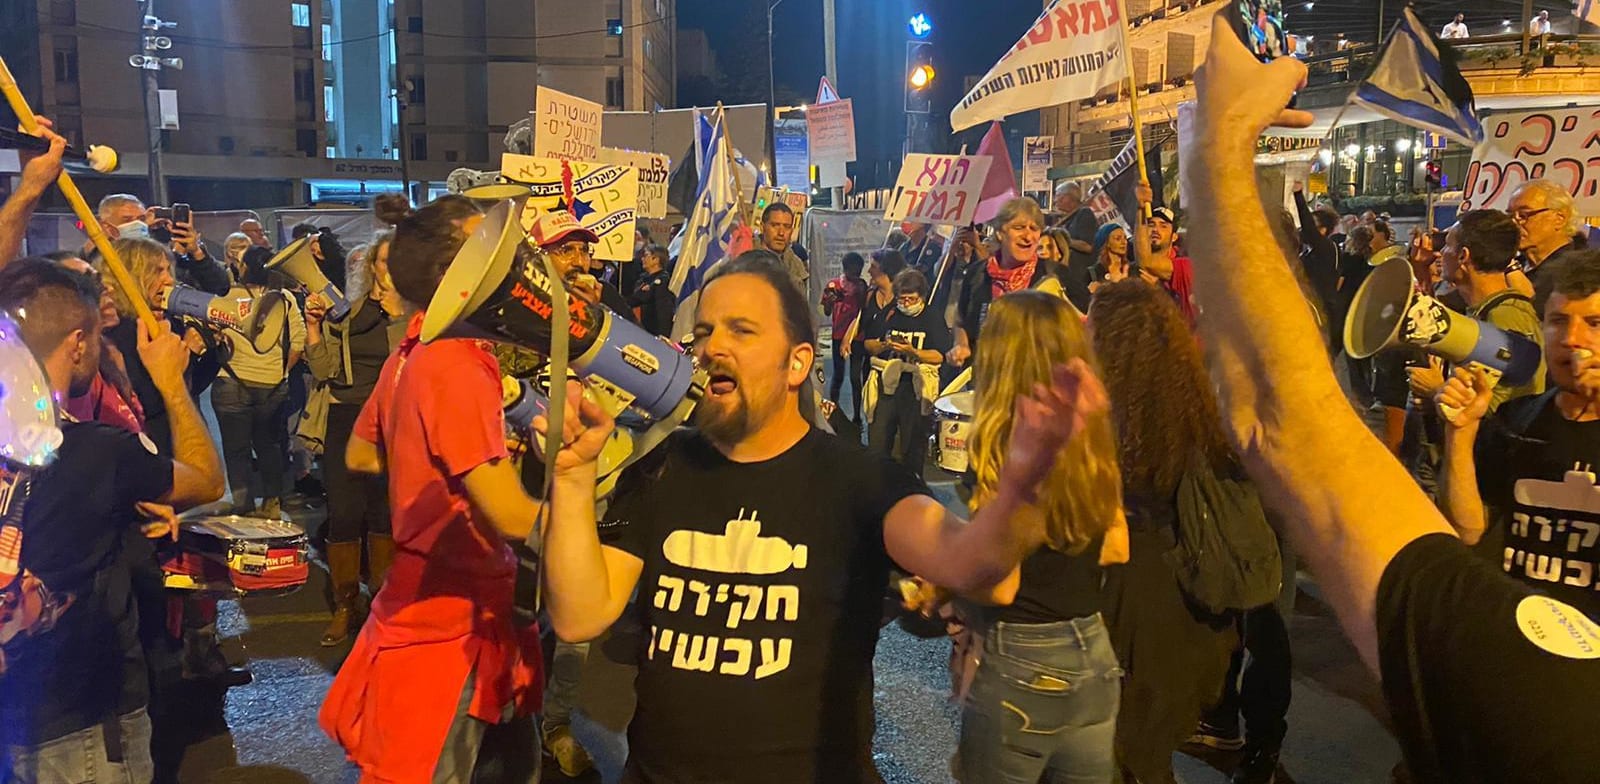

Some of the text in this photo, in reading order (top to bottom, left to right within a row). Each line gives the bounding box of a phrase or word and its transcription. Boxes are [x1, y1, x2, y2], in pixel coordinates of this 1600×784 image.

[1016, 58, 1060, 86] לאיכות
[1062, 50, 1104, 77] התנועה
[545, 101, 598, 126] משטרת
[519, 162, 547, 179] לא
[574, 163, 589, 179] כן
[915, 157, 970, 187] הוא
[600, 188, 620, 213] כן
[890, 185, 967, 221] גמור!
[605, 232, 624, 256] כן
[1511, 511, 1600, 552] קירה
[1503, 546, 1600, 589] כשיו
[653, 574, 799, 629] חקירה
[648, 624, 792, 680] עכשיו
